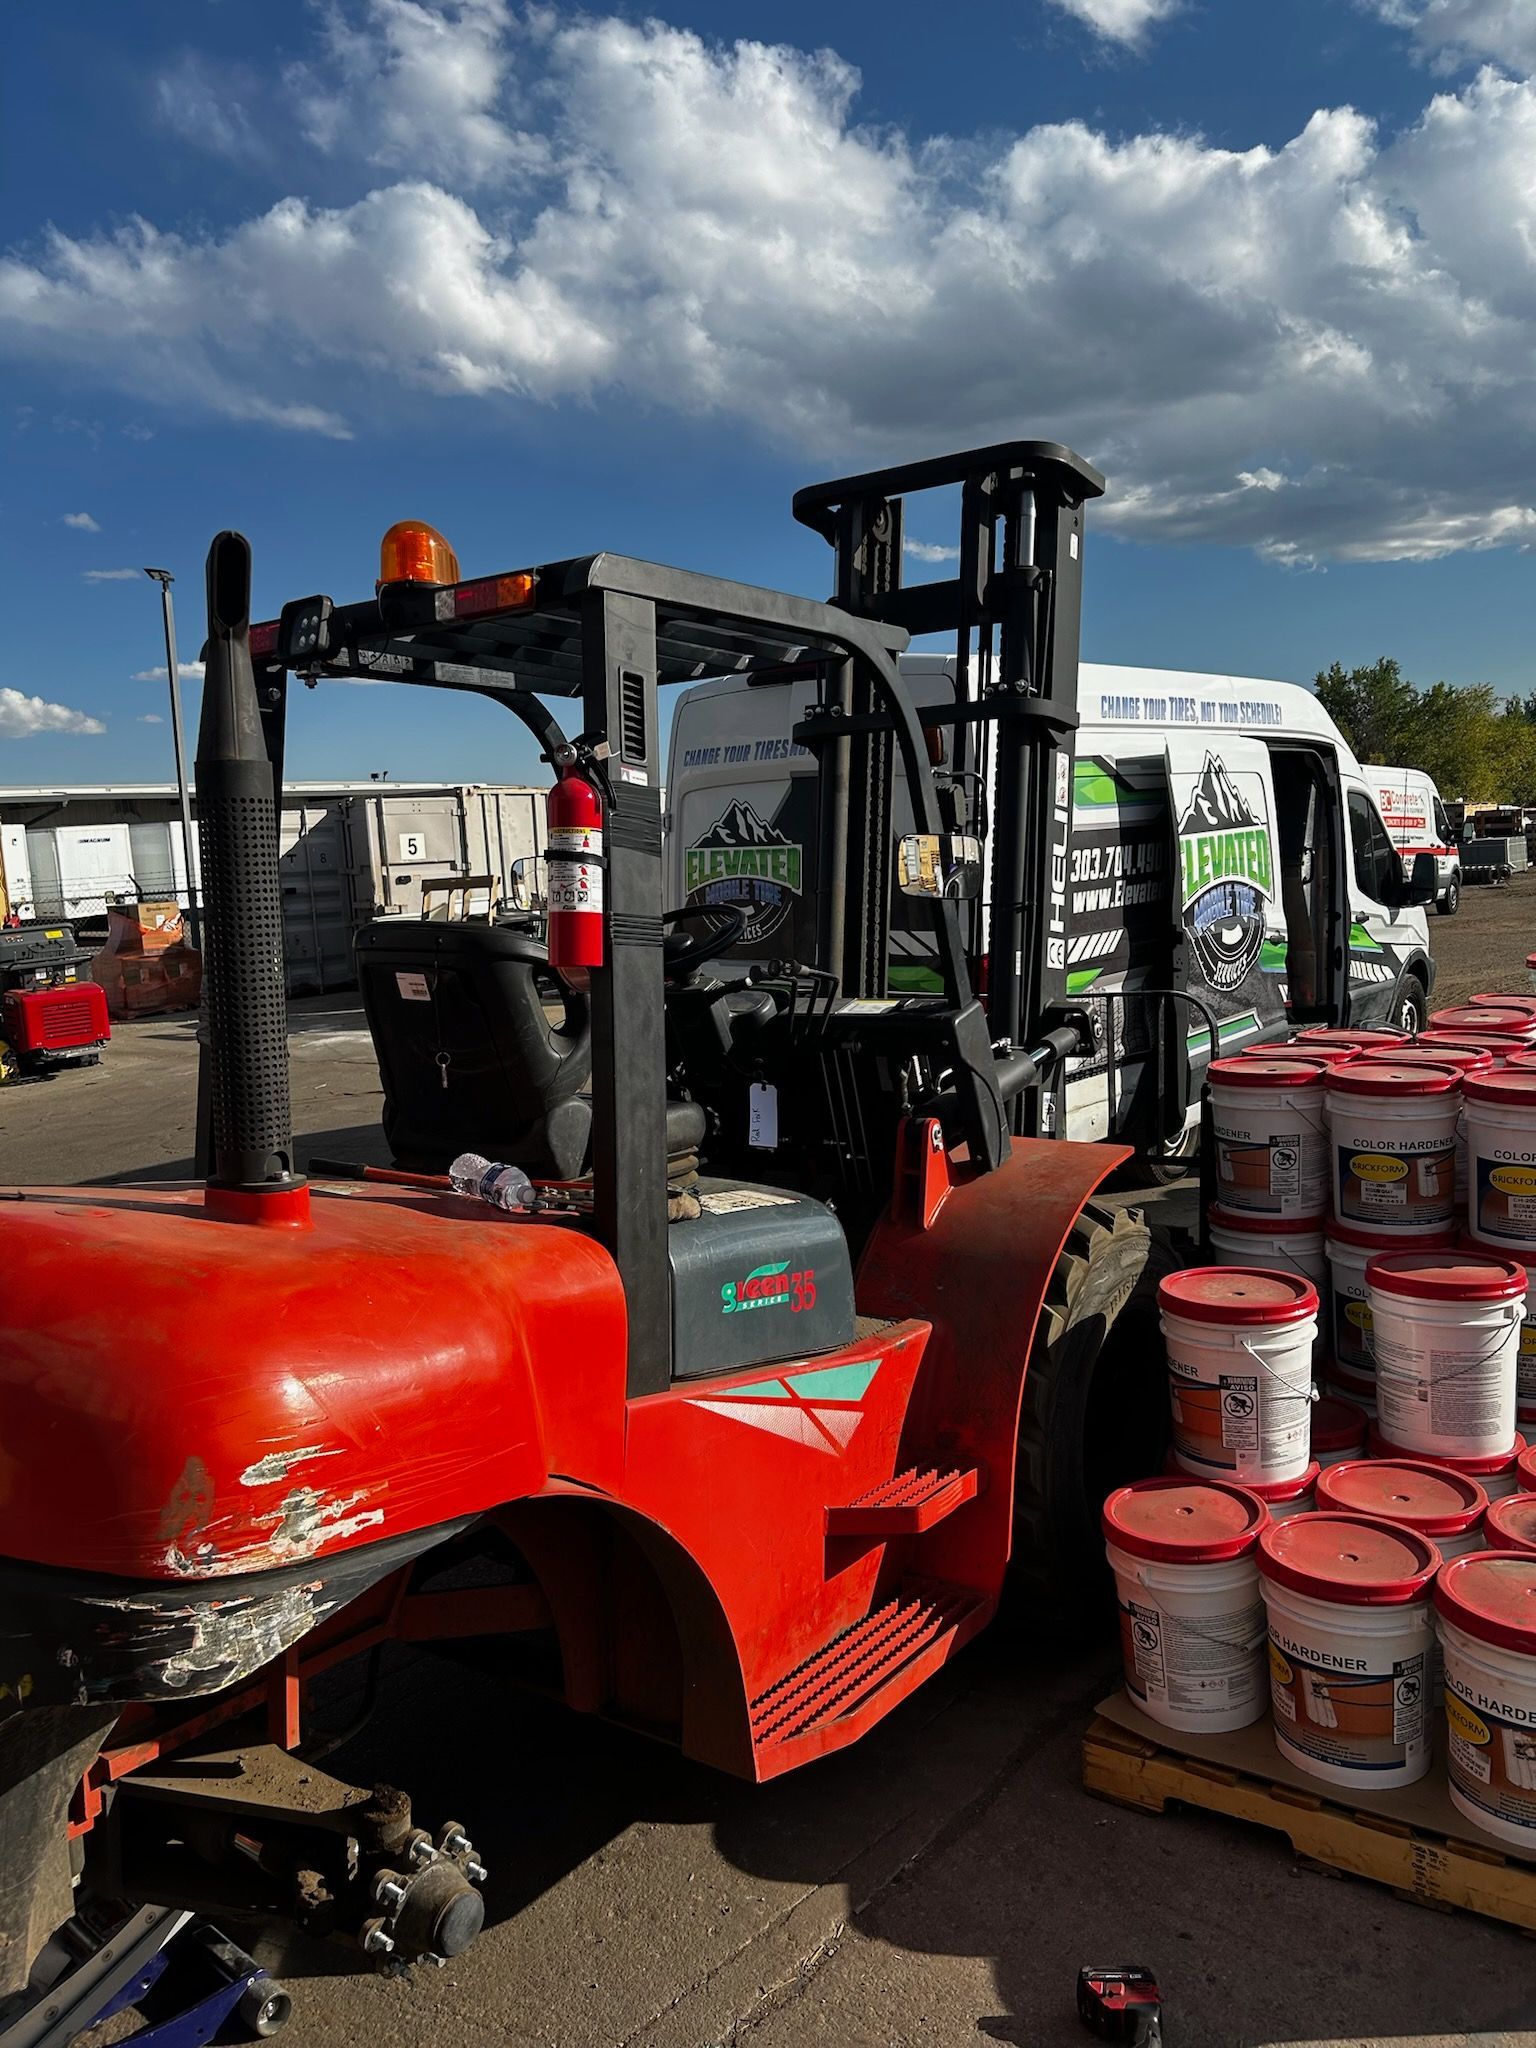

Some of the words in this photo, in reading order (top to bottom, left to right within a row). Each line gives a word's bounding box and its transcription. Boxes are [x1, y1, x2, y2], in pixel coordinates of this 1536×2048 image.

[1101, 695, 1140, 719] CHANGE
[1143, 697, 1167, 720] YOUR
[1168, 696, 1199, 724] TIRES,
[1200, 701, 1216, 722] NOT
[1218, 702, 1239, 724] YOUR
[683, 747, 720, 767] CHANGE
[723, 744, 751, 763] YOUR
[754, 739, 789, 760] TIRES
[408, 838, 417, 855] 5
[687, 847, 800, 890] ELEVATED
[1050, 808, 1068, 933] HELI
[1214, 952, 1248, 983] SERVICES
[1353, 1138, 1396, 1151] COLOR
[1399, 1136, 1455, 1151] HARDENER
[1352, 1161, 1405, 1174] BRICKFORM
[721, 1262, 790, 1313] green
[790, 1270, 817, 1312] 35
[1347, 1286, 1371, 1298] COL
[742, 1296, 783, 1309] SERIES
[1283, 1637, 1368, 1672] HARDENER
